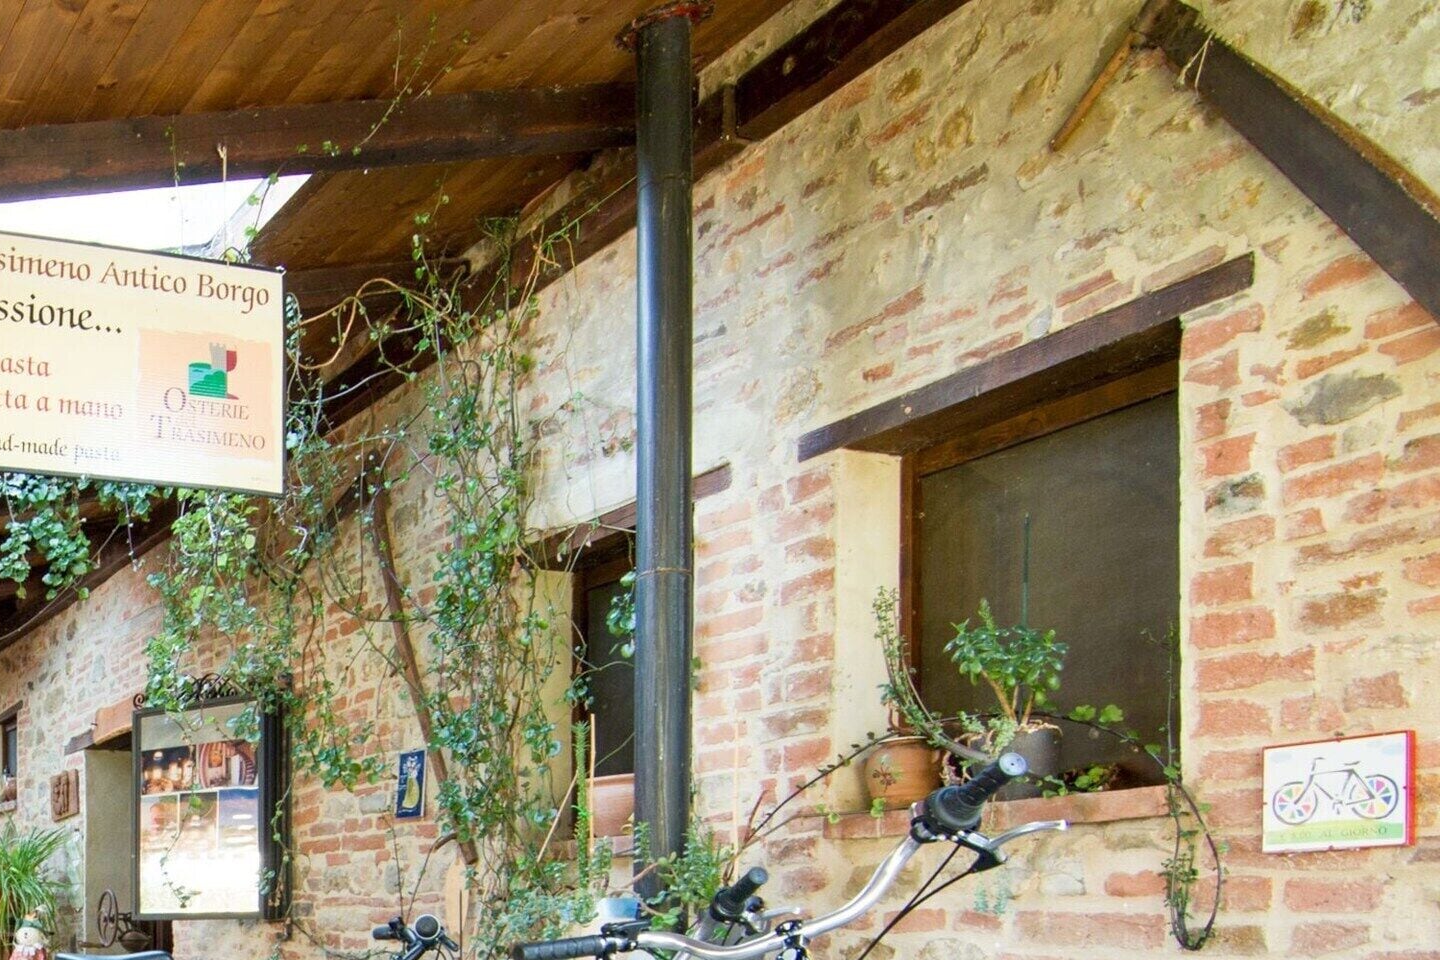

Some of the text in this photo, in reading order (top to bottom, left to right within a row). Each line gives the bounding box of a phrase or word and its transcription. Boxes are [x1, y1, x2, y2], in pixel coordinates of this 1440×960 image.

[100, 261, 187, 295] Antico
[196, 273, 270, 314] Borgo
[36, 394, 51, 413] a
[58, 396, 124, 421] mano
[164, 386, 250, 421] OSTERIE
[73, 443, 121, 465] pasta
